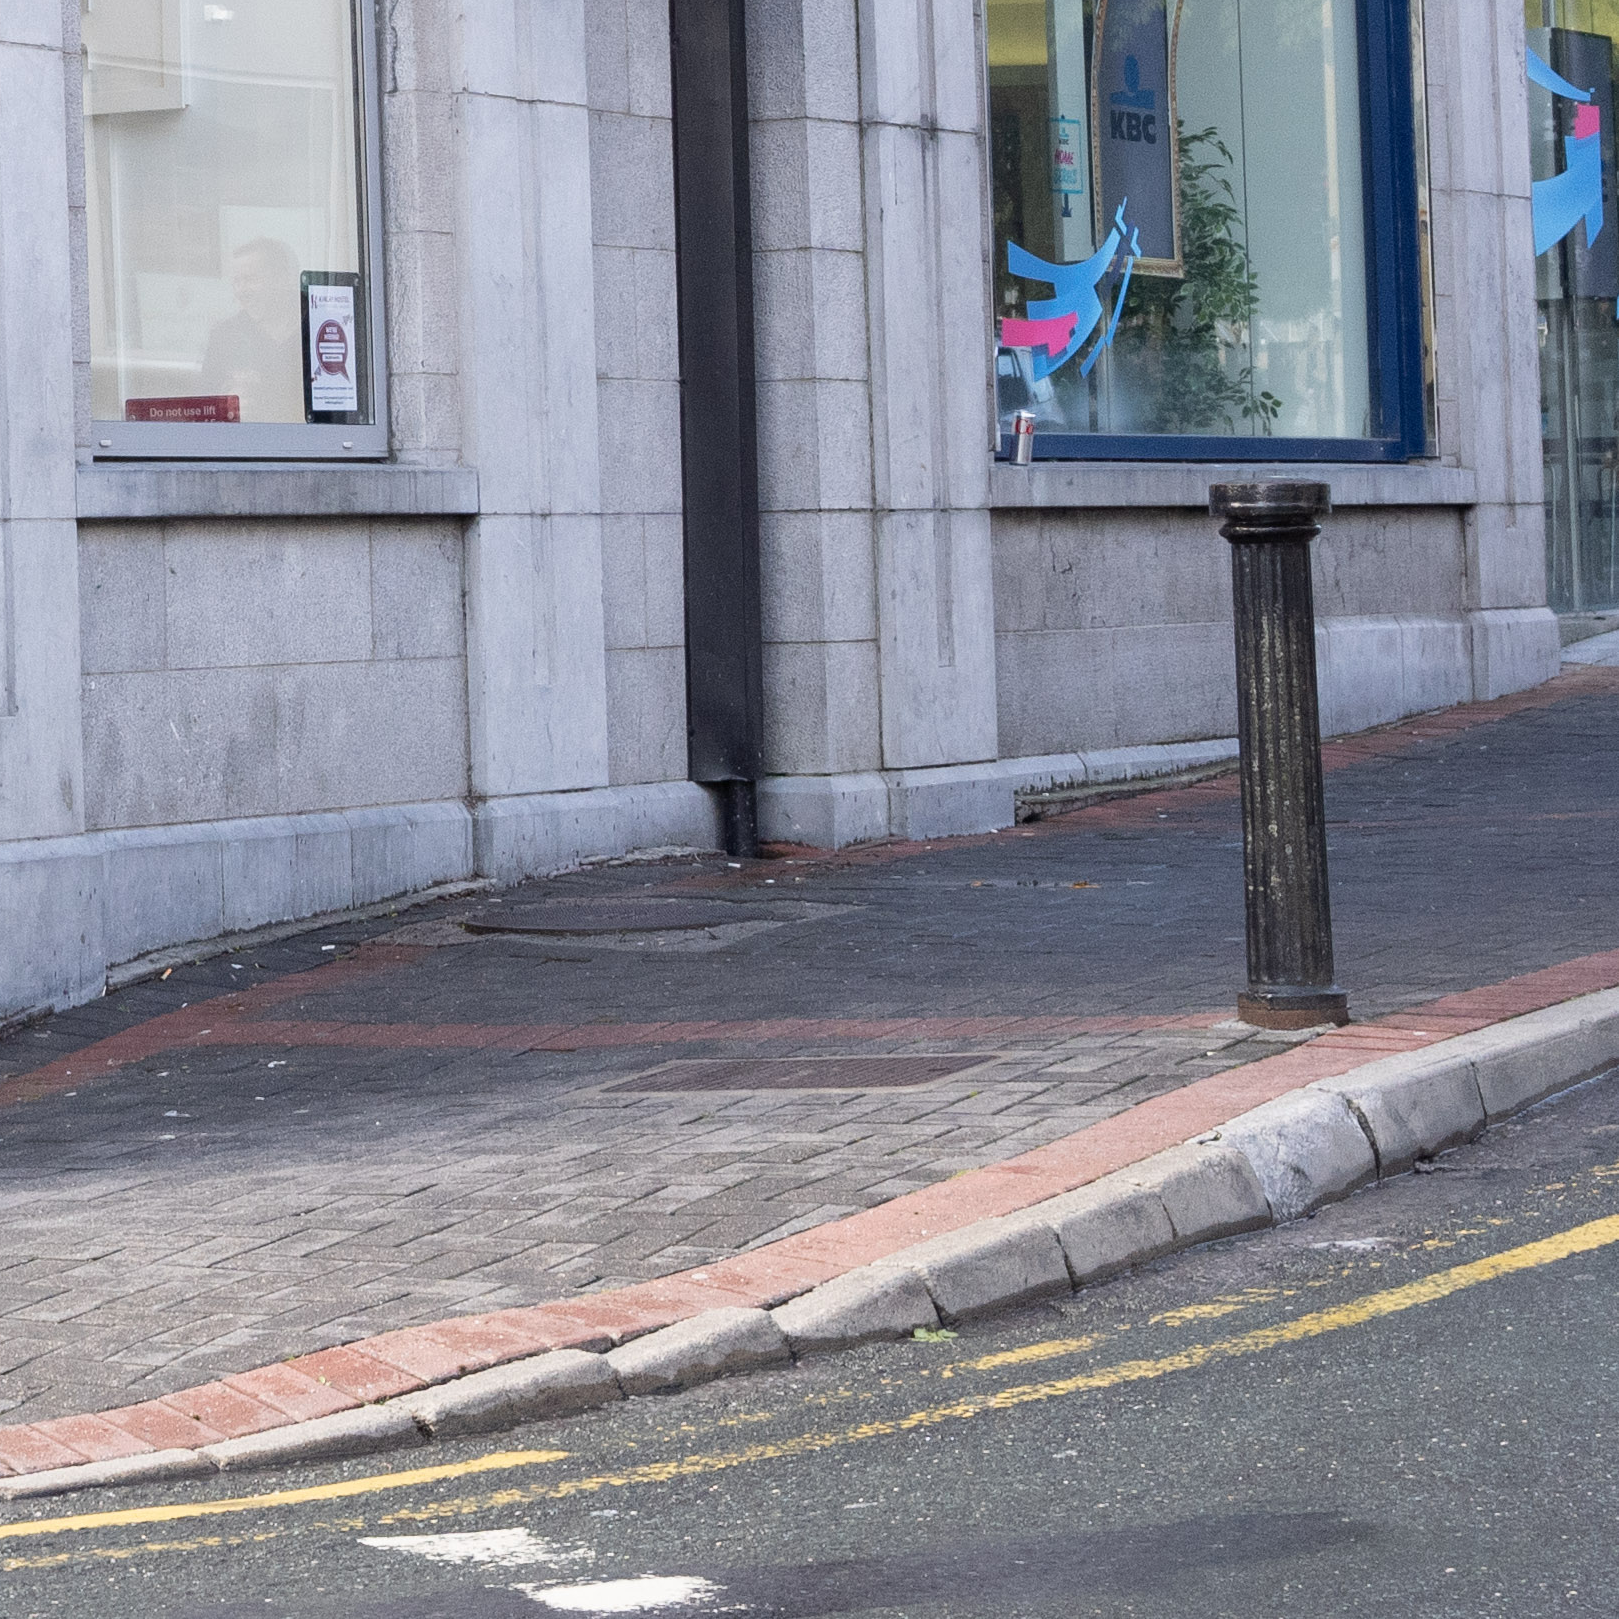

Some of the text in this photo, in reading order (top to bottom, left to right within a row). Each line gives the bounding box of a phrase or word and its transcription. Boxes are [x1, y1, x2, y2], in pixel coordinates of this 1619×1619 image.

[1110, 109, 1158, 145] KBC
[149, 405, 217, 418] Do not use lift
